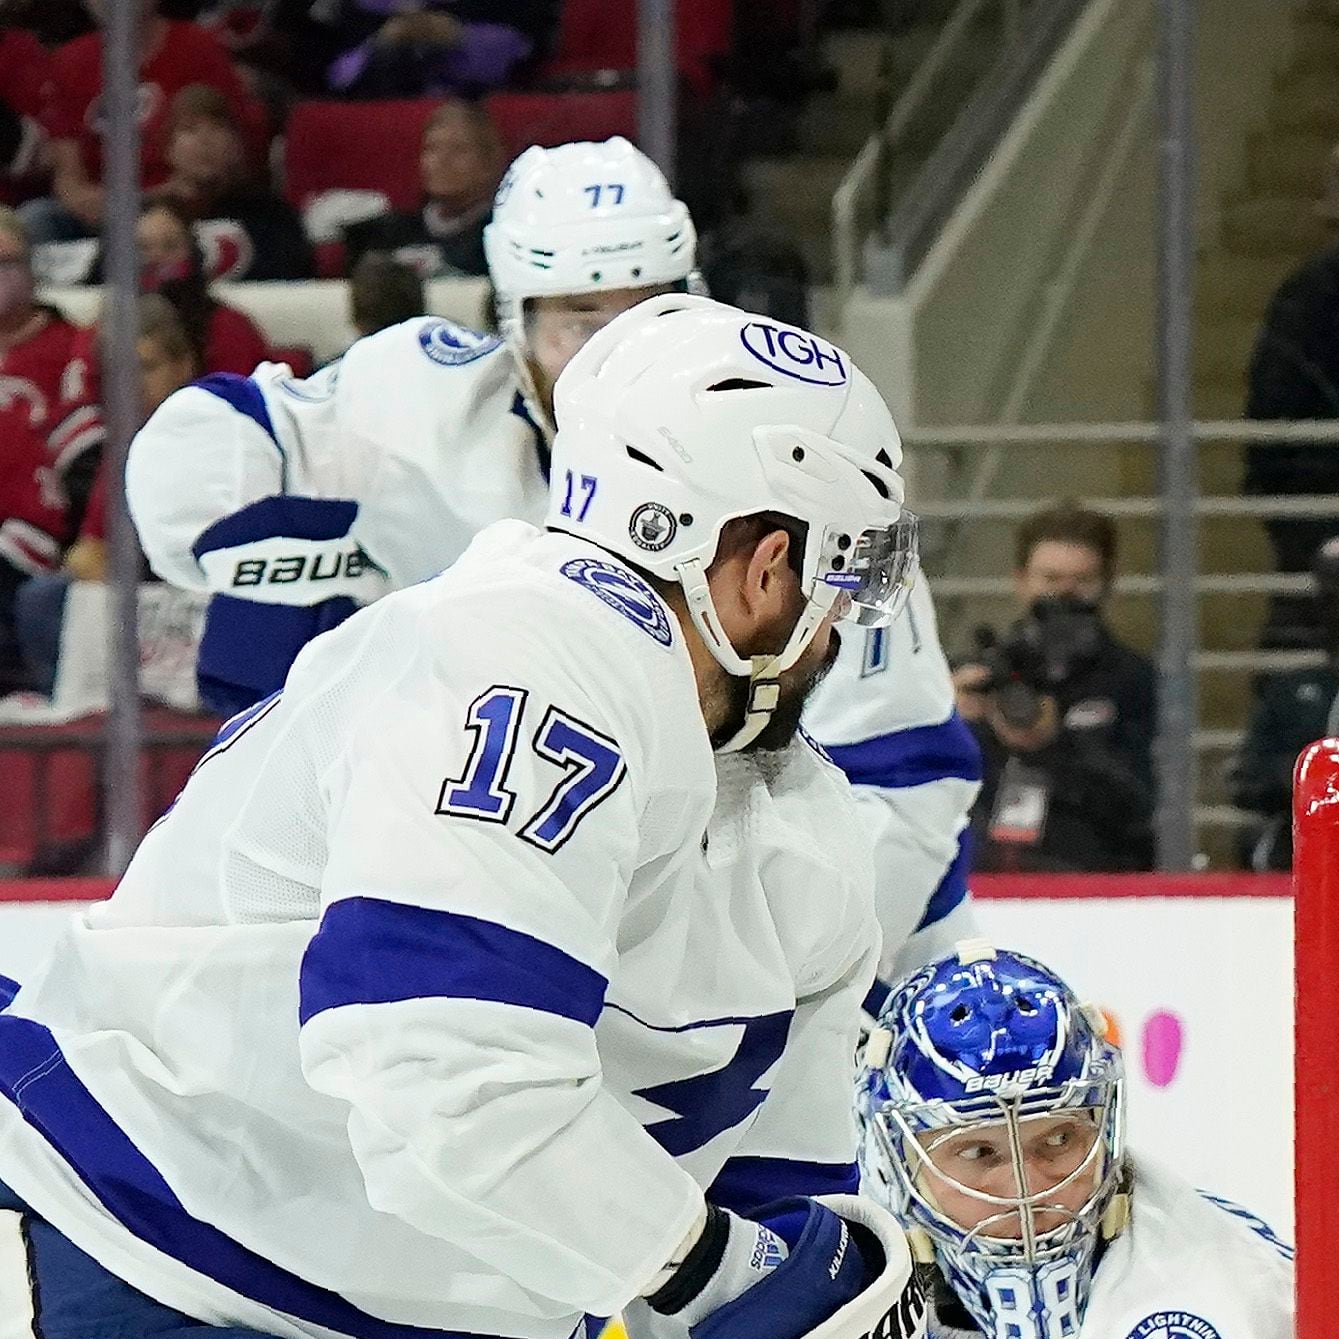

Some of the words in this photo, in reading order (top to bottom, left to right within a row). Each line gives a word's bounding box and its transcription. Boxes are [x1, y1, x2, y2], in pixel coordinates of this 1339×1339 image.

[583, 184, 625, 208] 77
[750, 323, 847, 380] TGH
[560, 469, 597, 522] 17
[434, 684, 629, 857] 17
[964, 1063, 1055, 1094] BAUER
